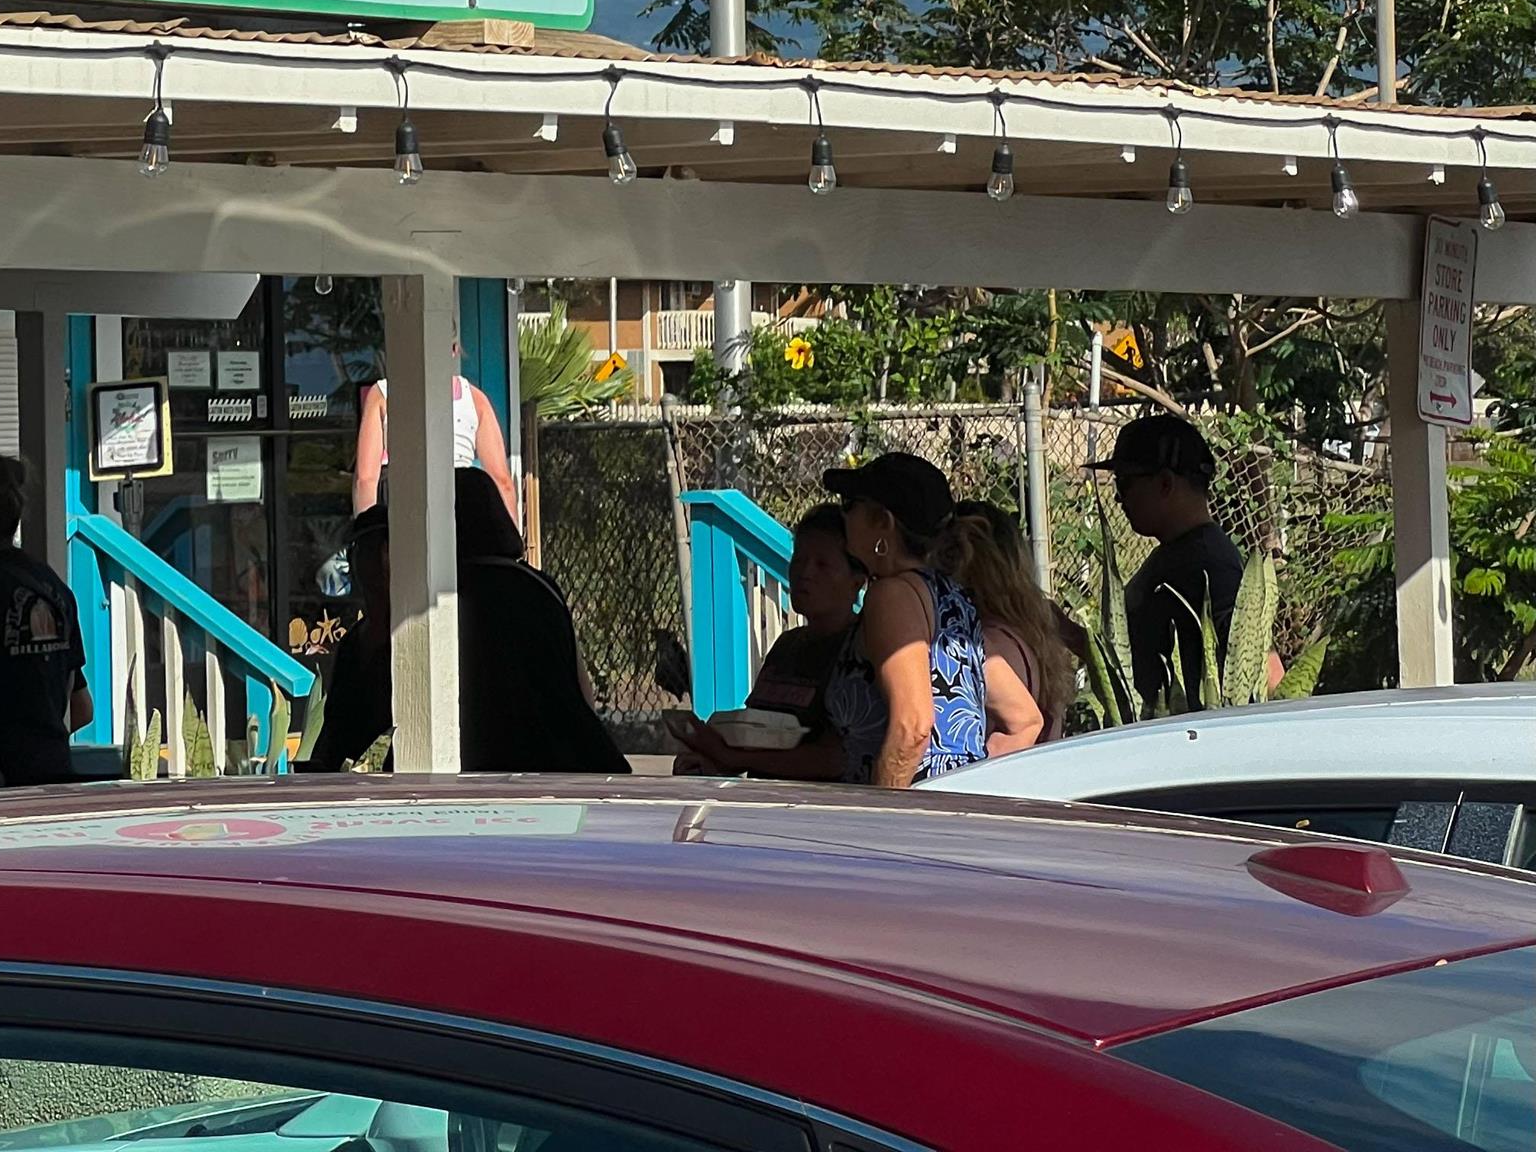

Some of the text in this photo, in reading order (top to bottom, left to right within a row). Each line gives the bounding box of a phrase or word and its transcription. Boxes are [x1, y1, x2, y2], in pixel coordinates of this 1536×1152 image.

[1435, 263, 1463, 293] STORE
[1428, 292, 1466, 324] PARKING
[1433, 324, 1457, 352] ONLY
